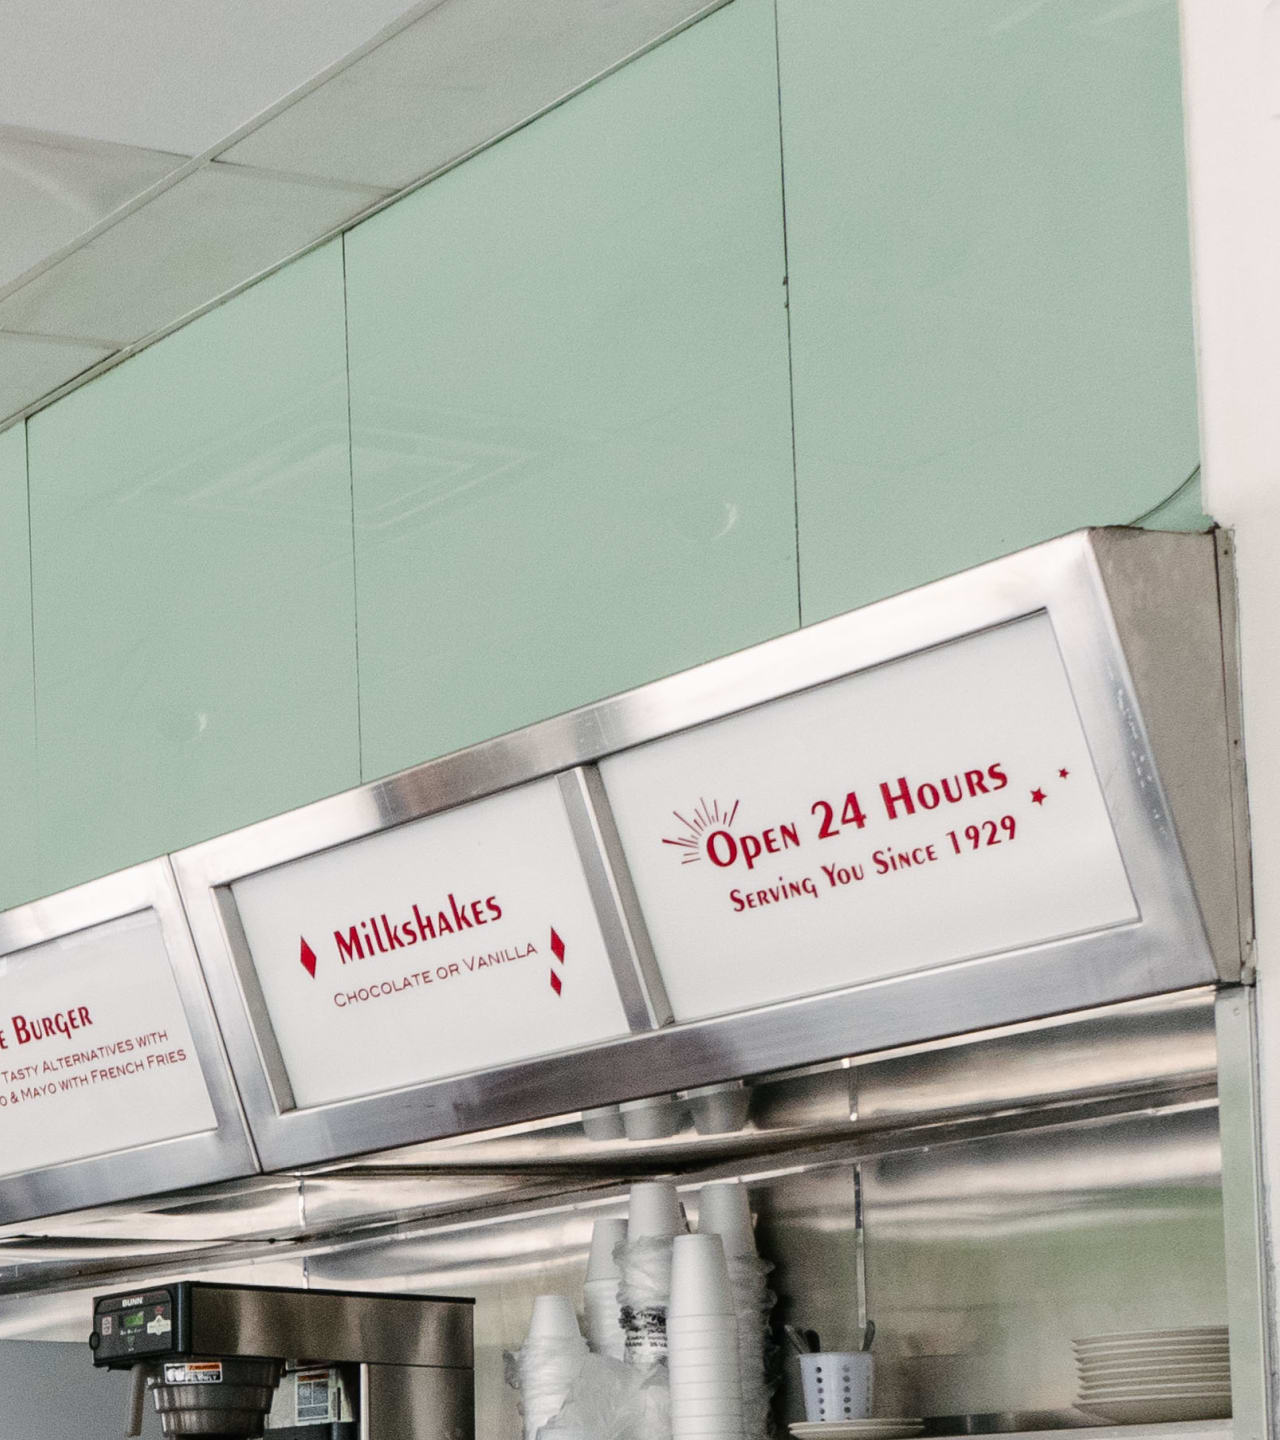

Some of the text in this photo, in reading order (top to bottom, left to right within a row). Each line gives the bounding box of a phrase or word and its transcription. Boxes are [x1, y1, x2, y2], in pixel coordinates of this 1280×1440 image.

[811, 791, 866, 839] 24
[945, 815, 1016, 854] 1929
[333, 893, 503, 964] Milkshakes
[10, 1091, 19, 1104] &
[122, 1296, 143, 1308] BUNN
